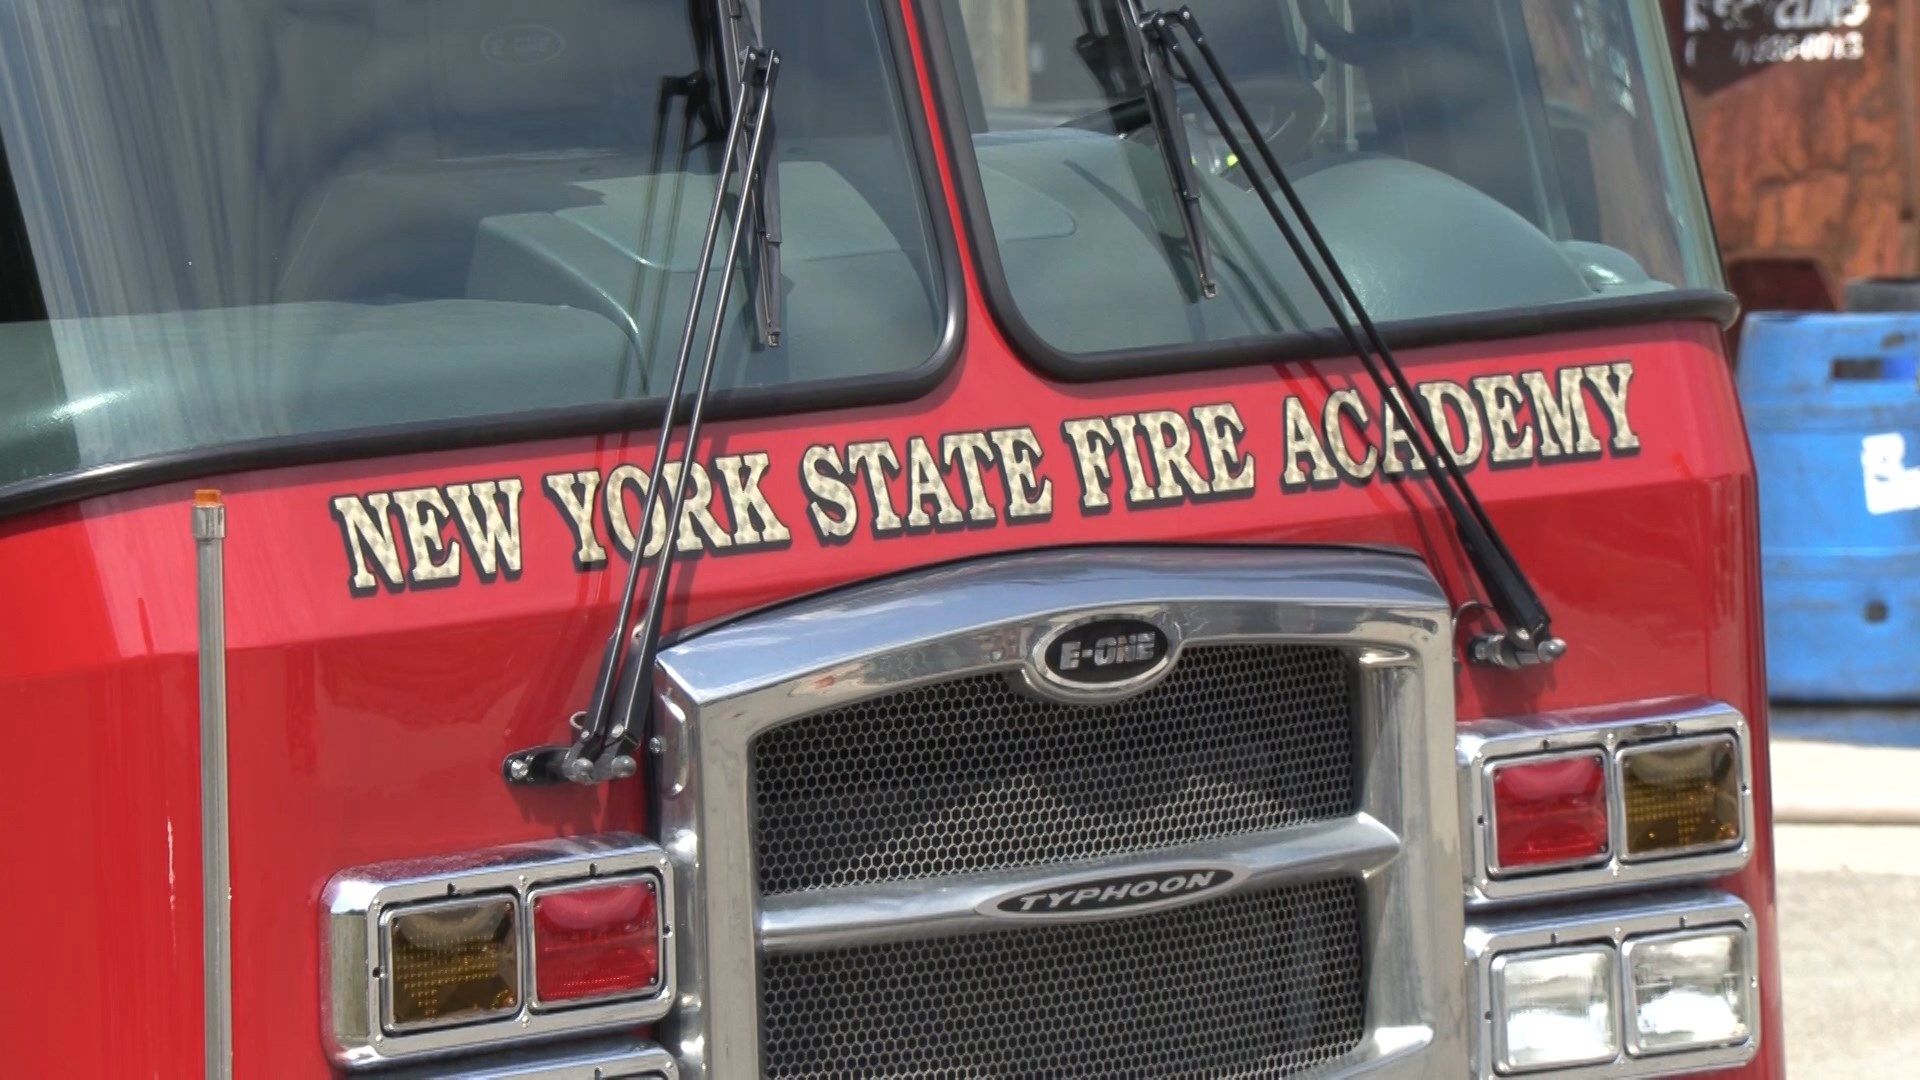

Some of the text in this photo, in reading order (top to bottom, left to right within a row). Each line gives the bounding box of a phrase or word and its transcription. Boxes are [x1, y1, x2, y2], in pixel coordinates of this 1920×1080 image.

[332, 361, 1641, 594] NEW YORK STATE FIRE ACADEMY
[1059, 631, 1156, 671] E-ONE
[1019, 870, 1216, 912] TYPHOON
